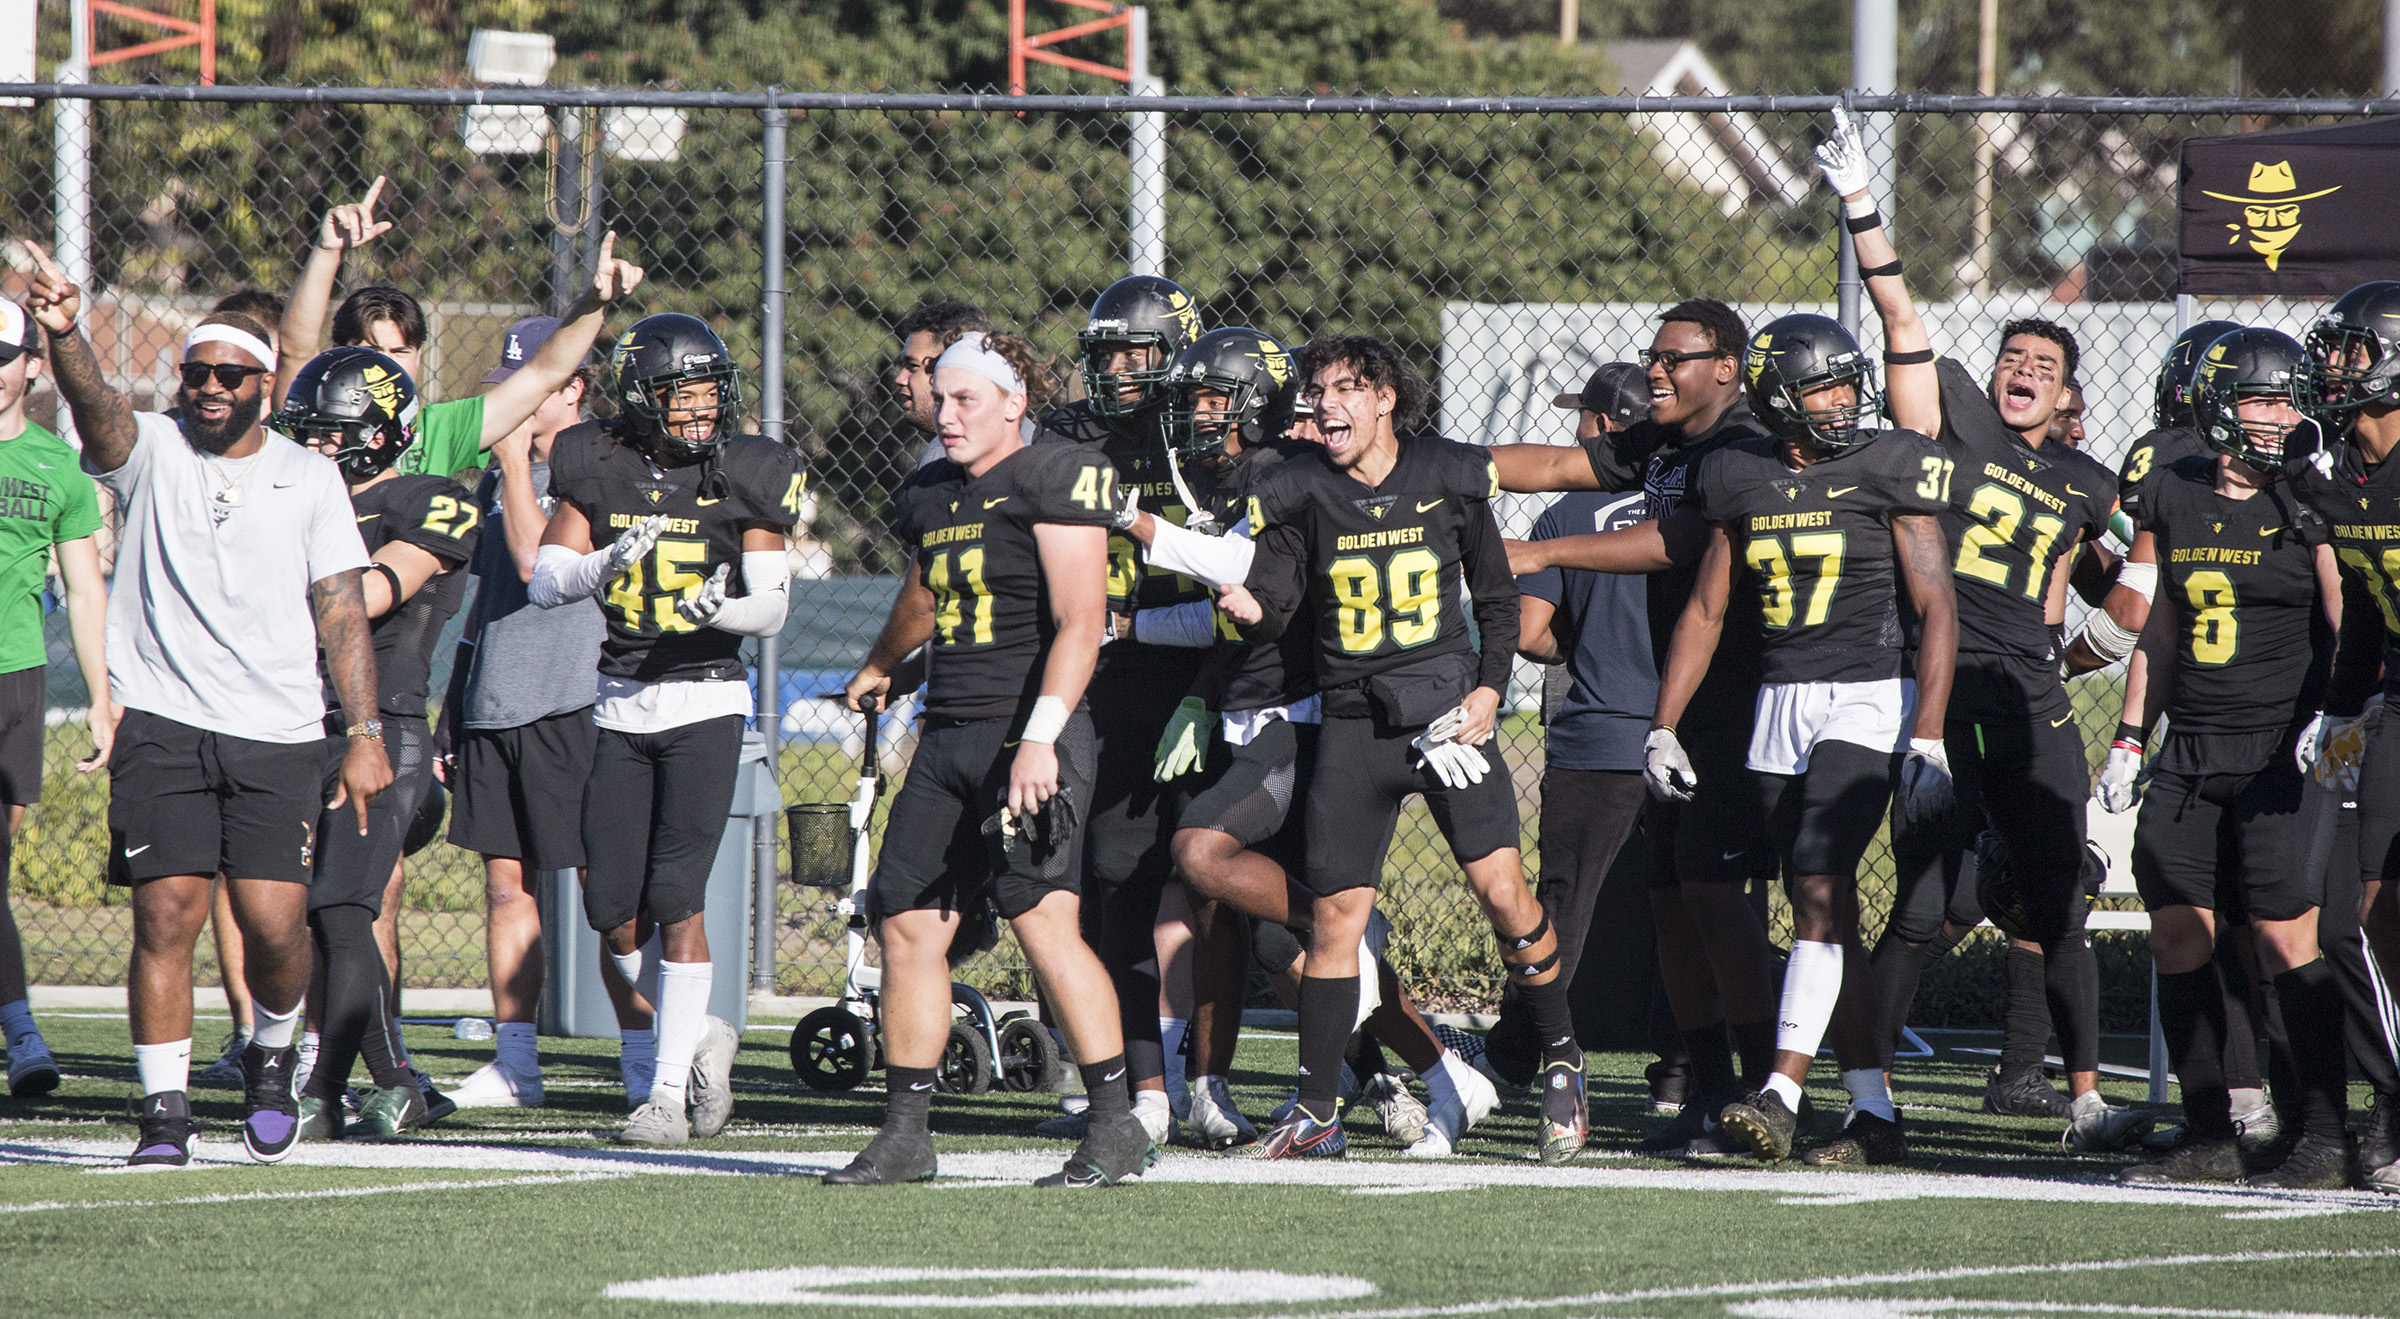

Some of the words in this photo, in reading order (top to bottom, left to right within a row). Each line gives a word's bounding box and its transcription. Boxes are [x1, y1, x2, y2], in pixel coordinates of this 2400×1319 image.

[507, 334, 523, 361] LA
[1070, 464, 1113, 512] 41
[2126, 446, 2155, 483] 3
[420, 494, 479, 541] 27
[609, 512, 650, 529] GOLD
[1627, 508, 1641, 516] THE
[1953, 481, 2067, 603] 21
[604, 533, 710, 634] 45
[927, 543, 996, 647] 41
[1326, 545, 1442, 655] 89
[1745, 529, 1847, 630] 37
[2184, 566, 2241, 668] 8
[711, 669, 719, 678] L
